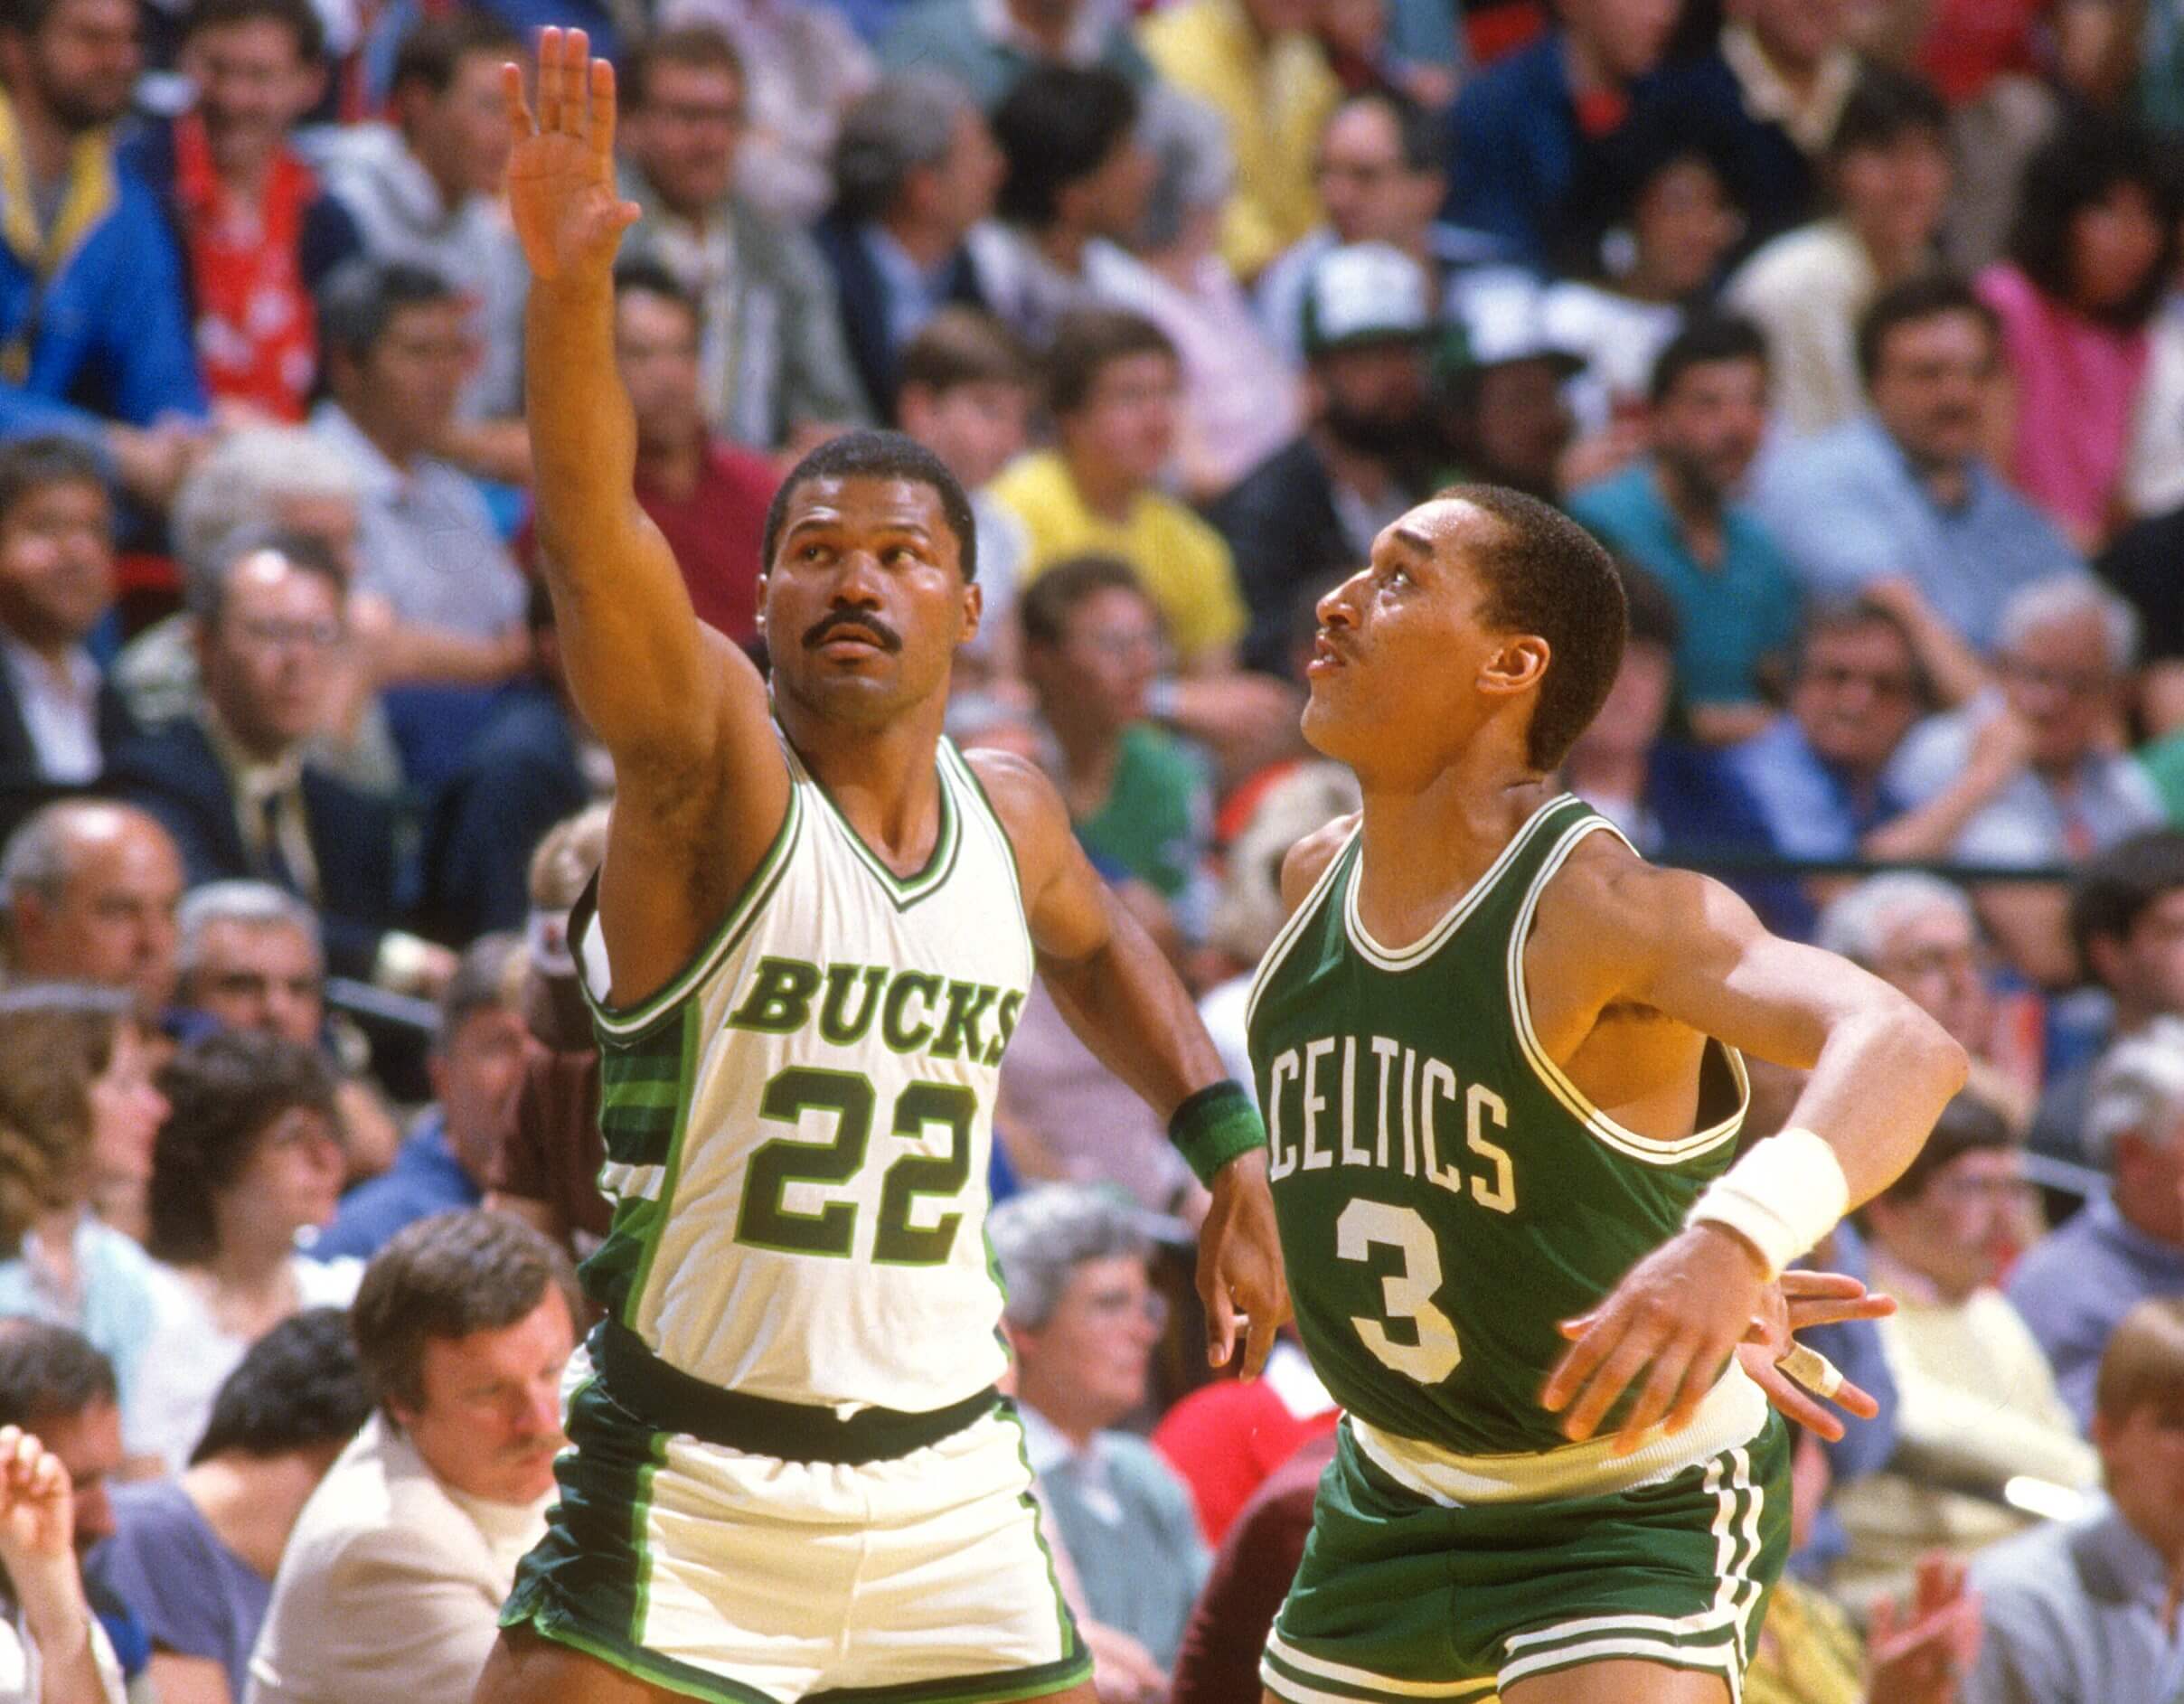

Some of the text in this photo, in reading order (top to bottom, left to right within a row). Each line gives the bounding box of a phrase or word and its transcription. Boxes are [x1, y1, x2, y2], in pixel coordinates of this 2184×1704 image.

[723, 956, 1025, 1068] BUCKS
[733, 1065, 978, 1266] 22
[1270, 1035, 1516, 1214] CELTICS
[1336, 1198, 1463, 1384] 3
